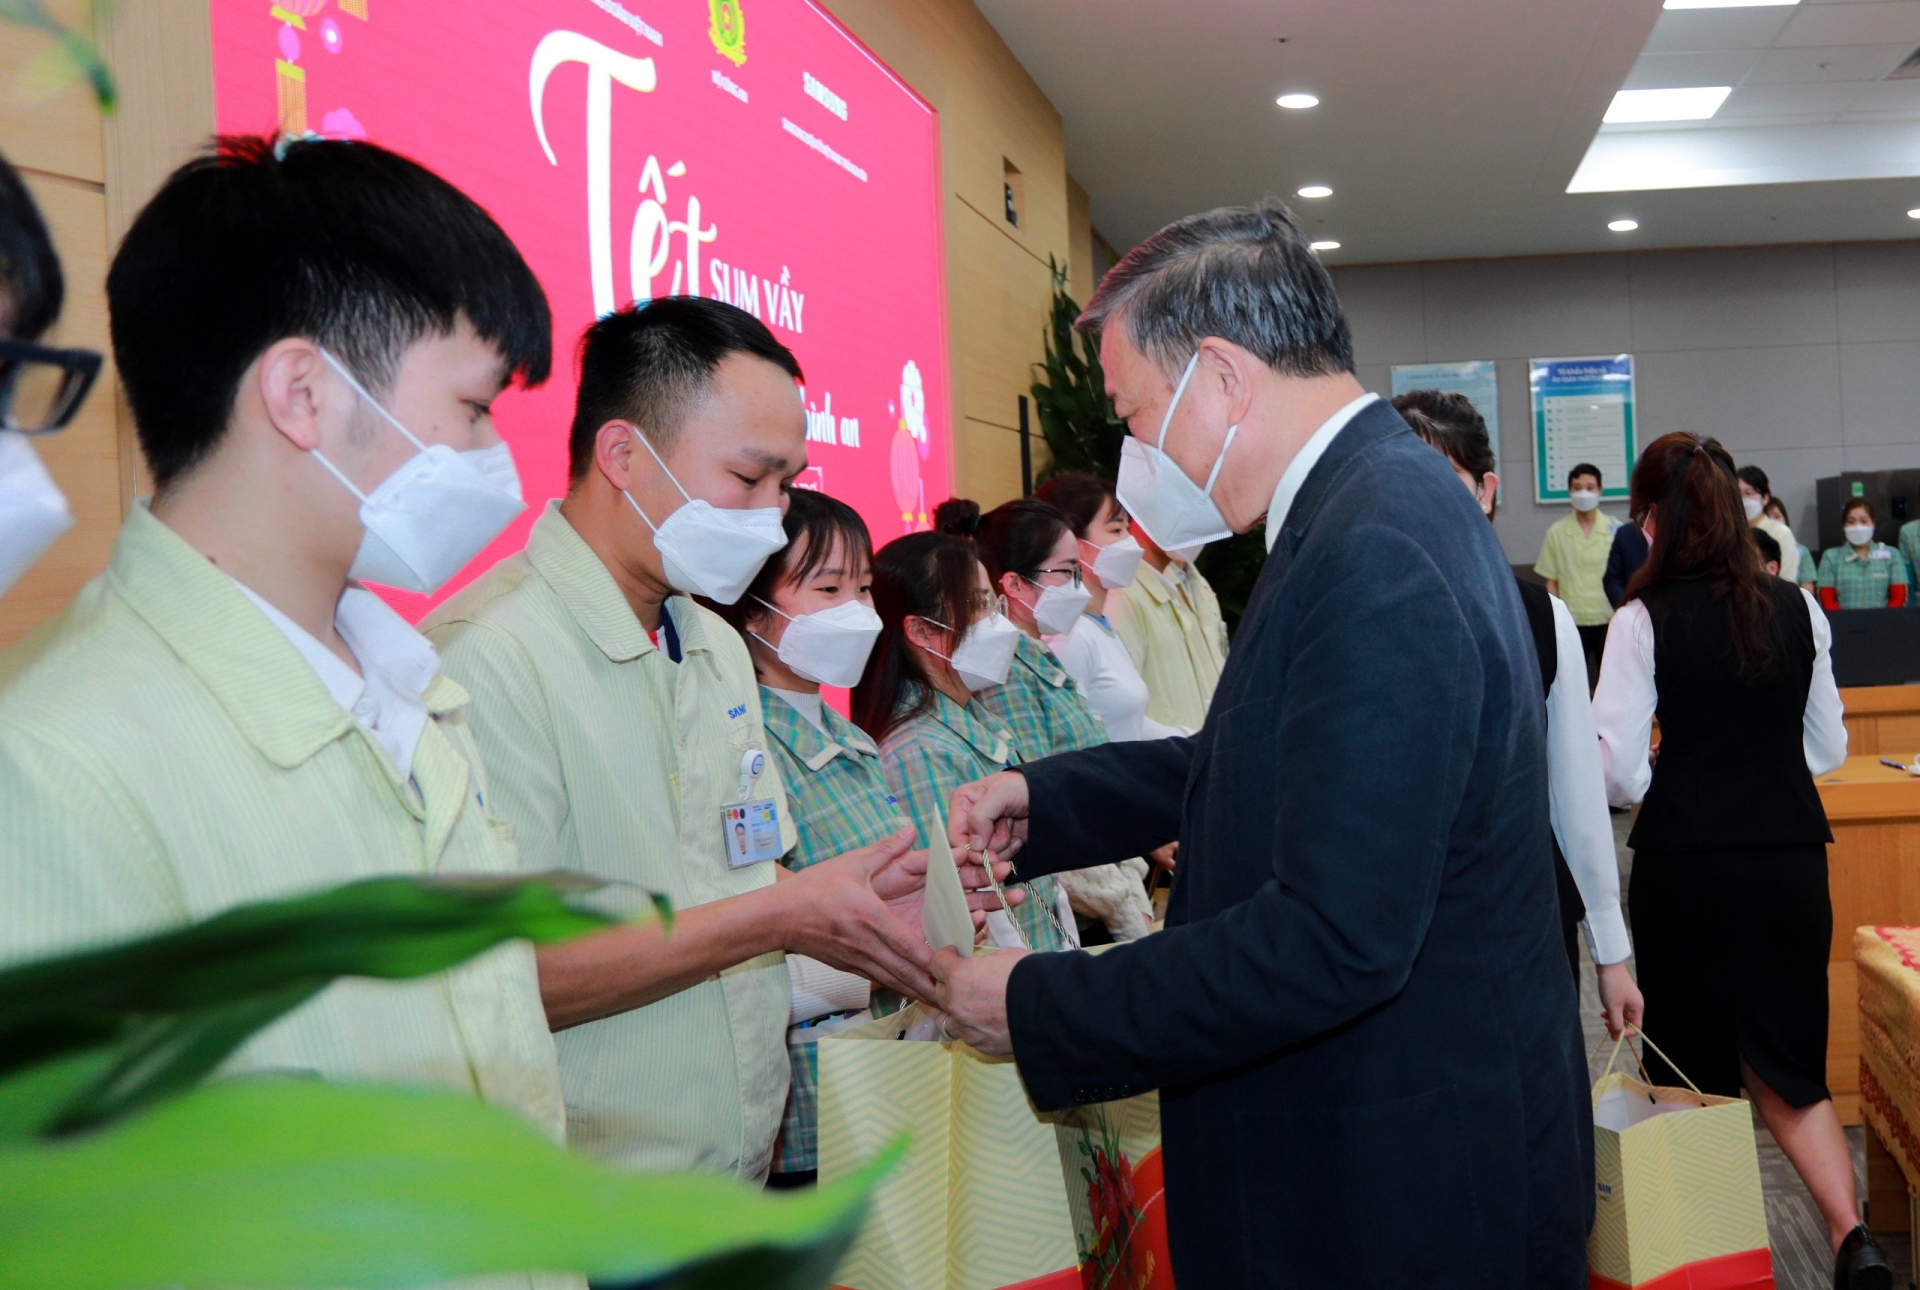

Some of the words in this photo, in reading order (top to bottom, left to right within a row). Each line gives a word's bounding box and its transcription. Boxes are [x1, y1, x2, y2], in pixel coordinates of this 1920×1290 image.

[529, 29, 718, 322] Tết
[709, 258, 761, 320] SUM
[763, 265, 804, 334] VẦY
[840, 416, 860, 449] an
